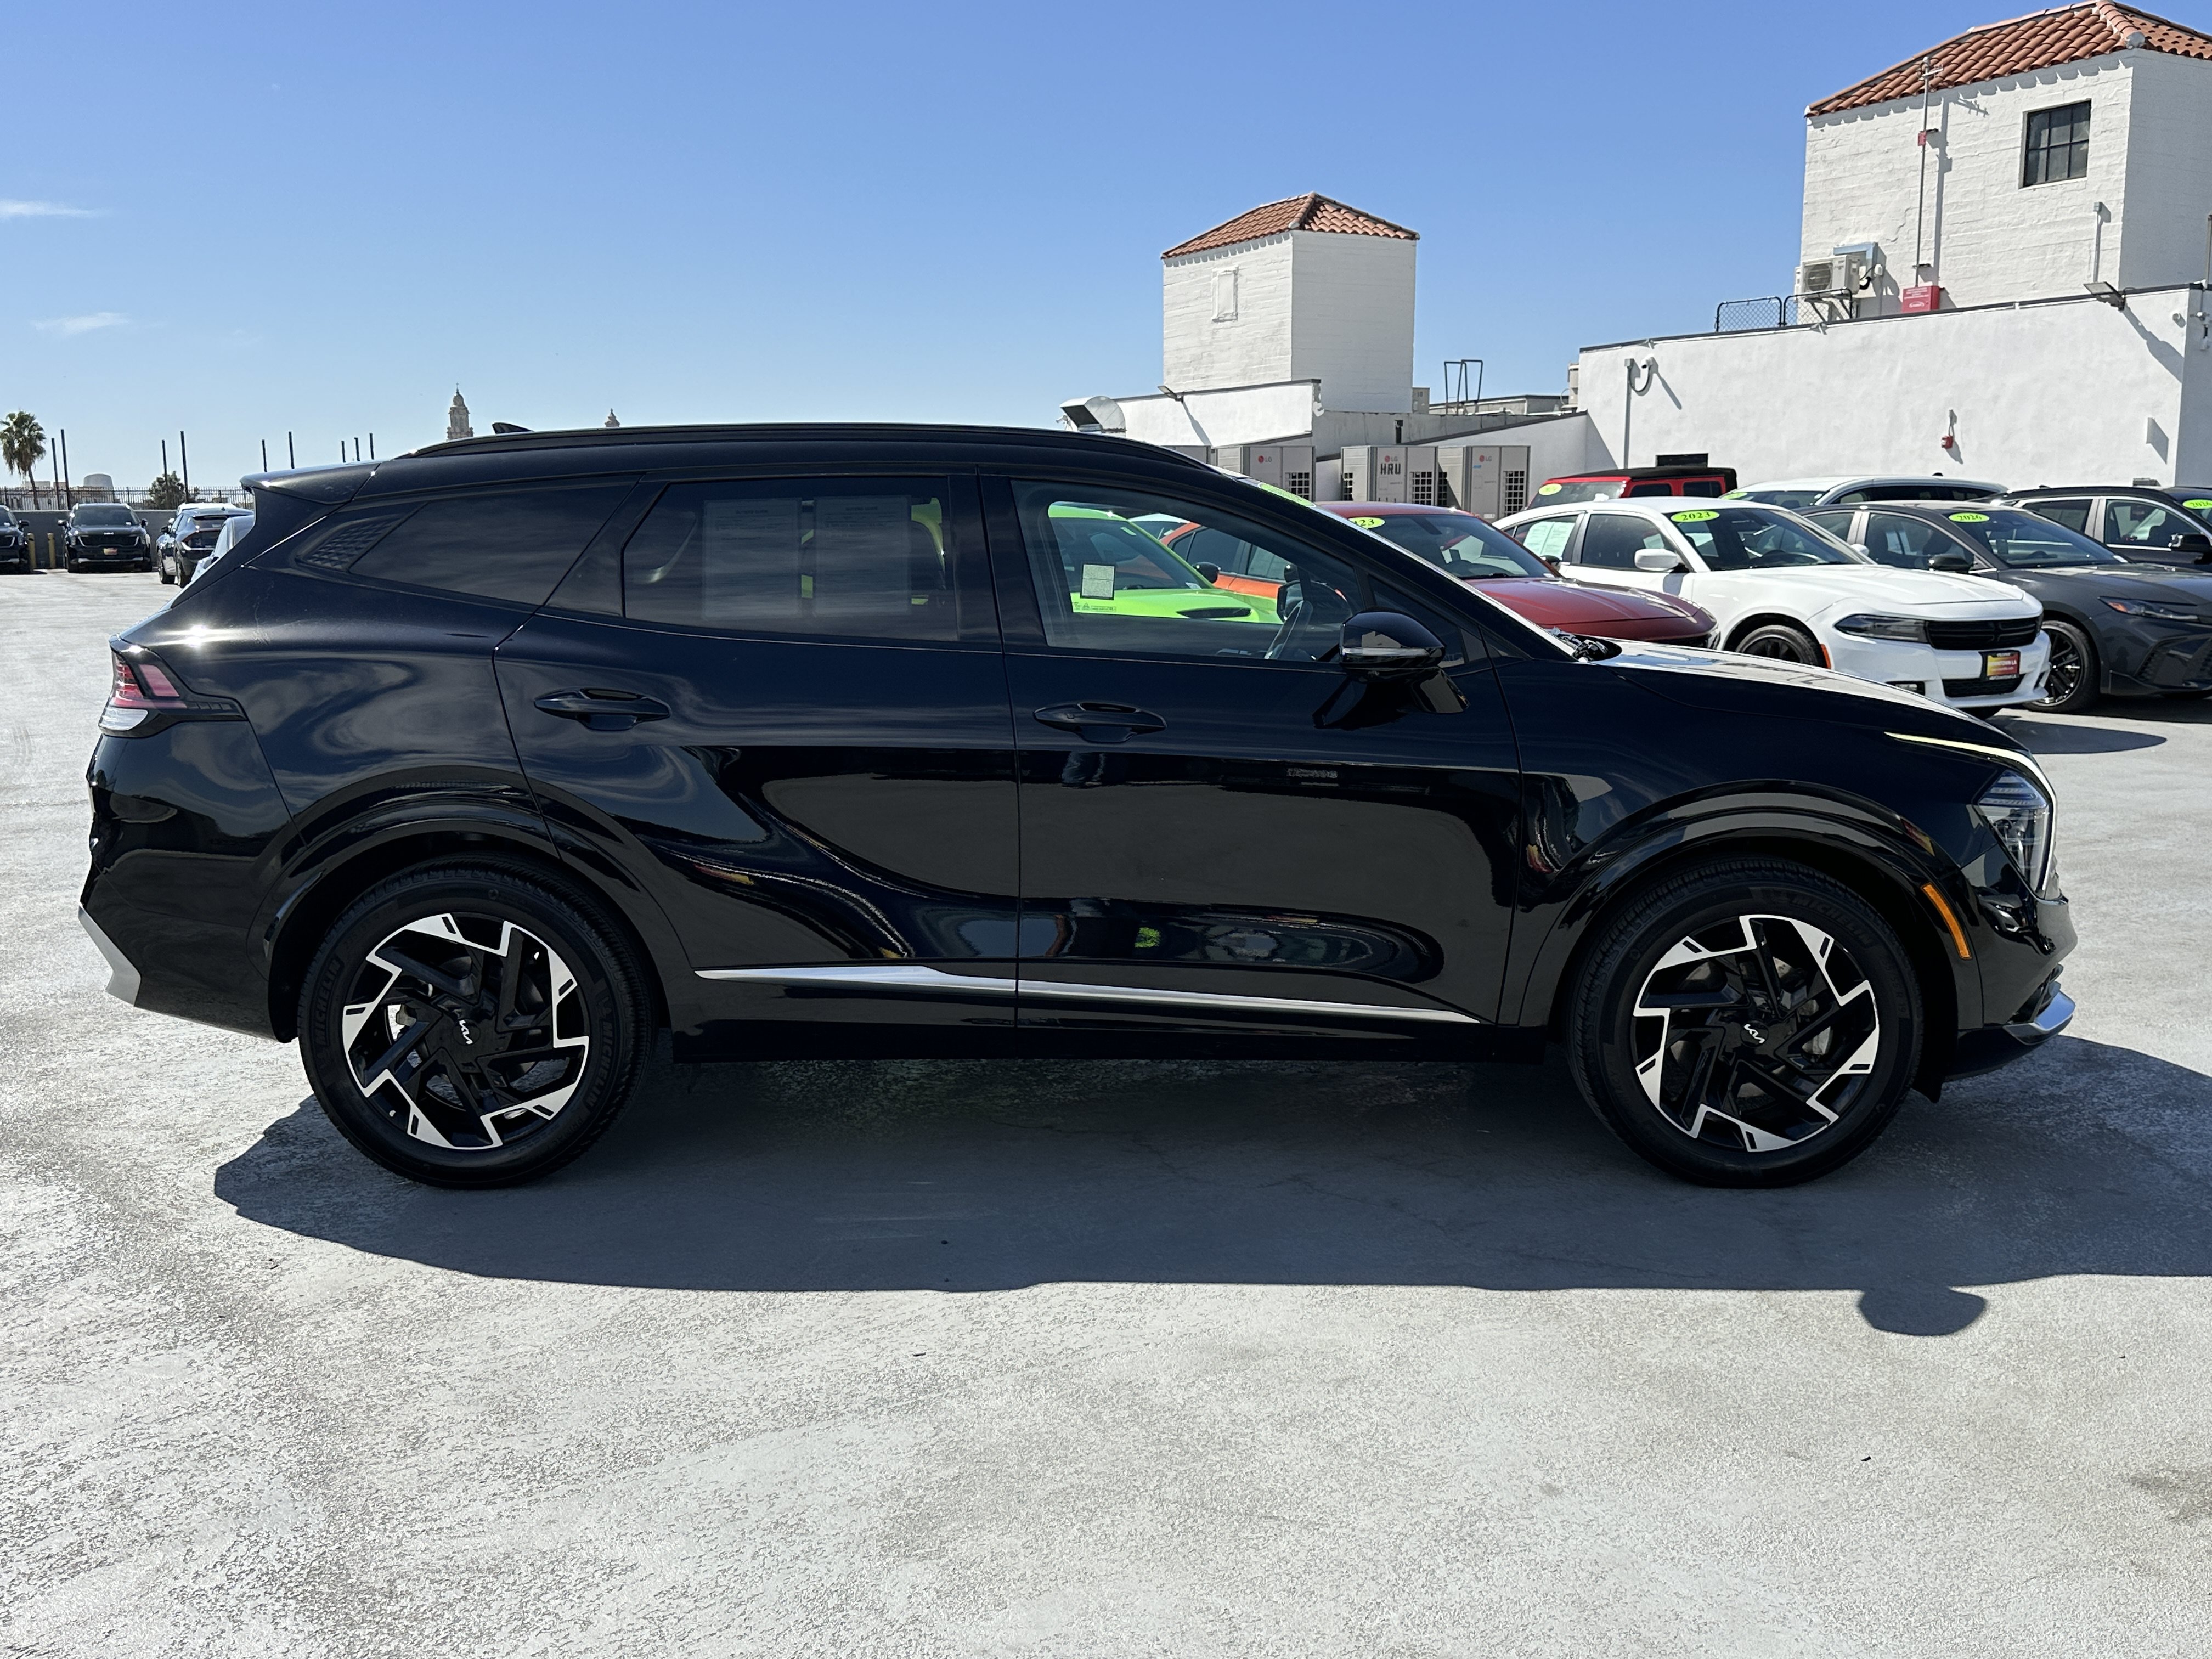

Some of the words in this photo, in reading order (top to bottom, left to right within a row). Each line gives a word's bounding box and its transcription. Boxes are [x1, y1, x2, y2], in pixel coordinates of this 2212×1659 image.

[1380, 463, 1401, 475] HRU
[1353, 518, 1375, 527] 23
[1680, 511, 1711, 521] 2023
[1792, 896, 1874, 945] MICHELIN
[314, 957, 341, 1046] MICHELIN
[587, 1019, 614, 1108] MICHELIN
